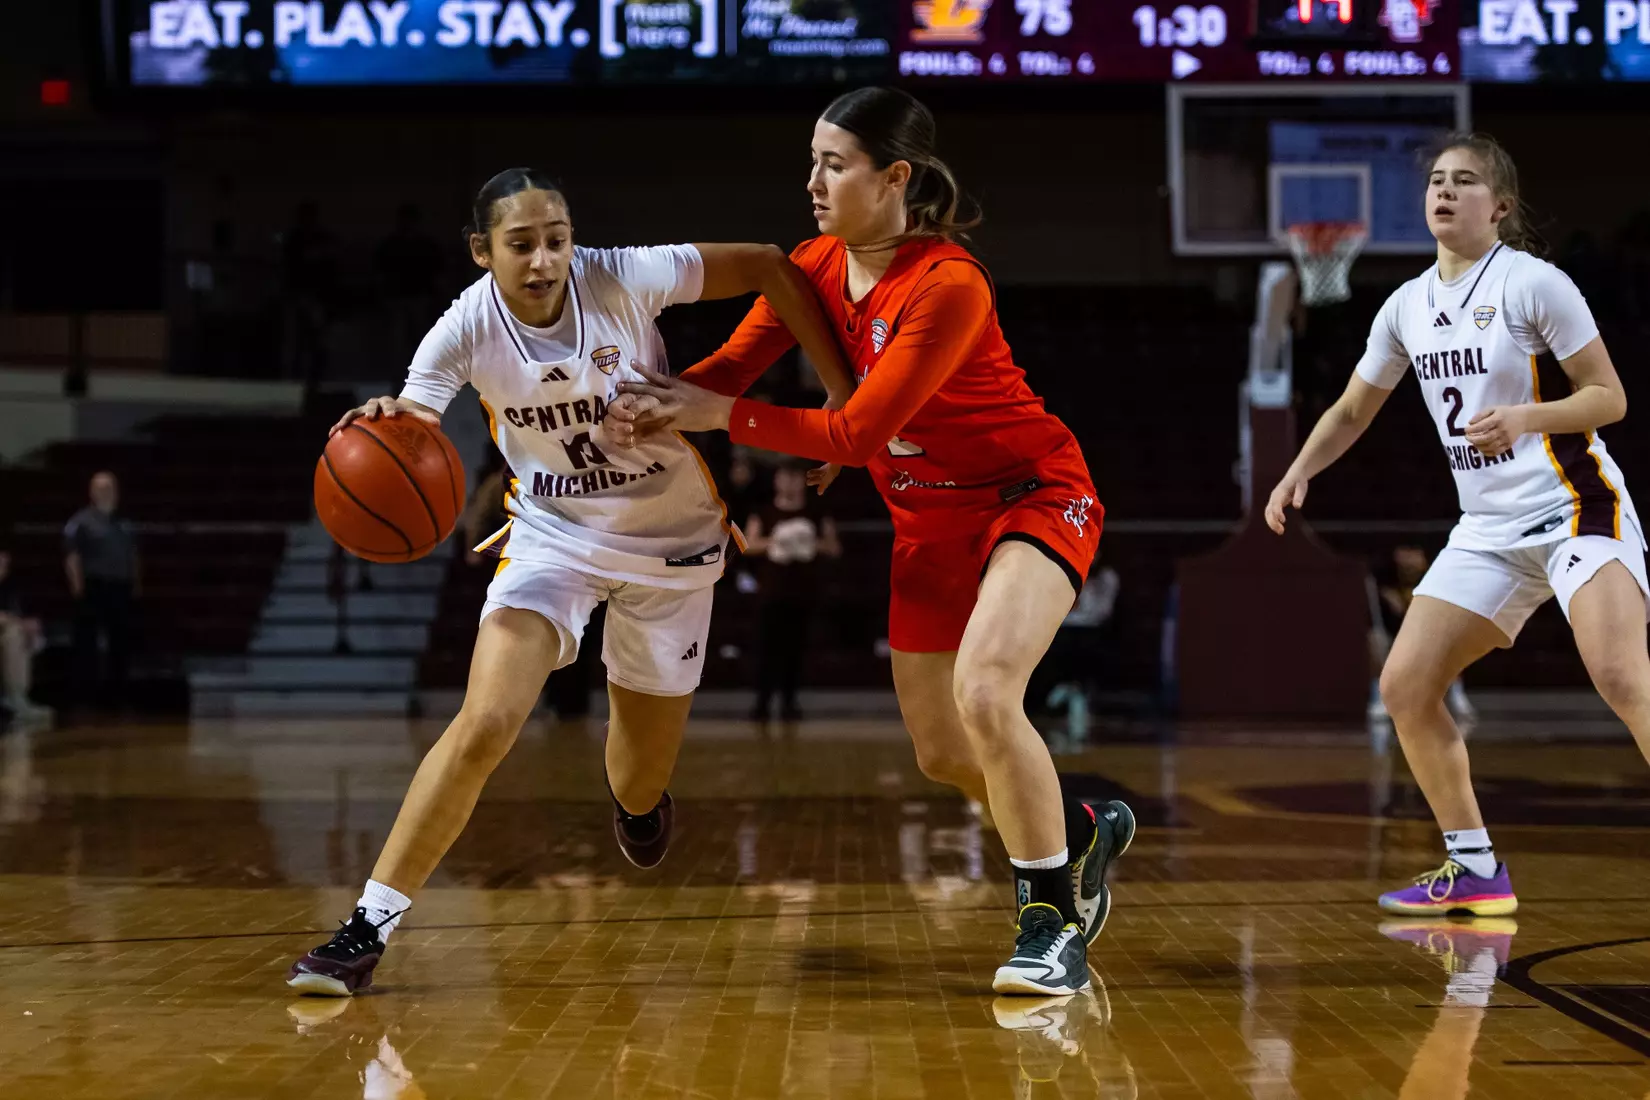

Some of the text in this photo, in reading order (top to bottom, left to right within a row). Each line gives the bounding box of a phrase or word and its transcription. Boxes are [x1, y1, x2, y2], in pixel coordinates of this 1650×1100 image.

[150, 0, 591, 48] EAT. PLAY. STAY.
[1133, 4, 1227, 47] 1:30
[1478, 0, 1594, 46] EAT.
[899, 51, 983, 76] FOULS:
[1343, 50, 1427, 75] FOULS:
[1415, 348, 1488, 380] CENTRAL
[504, 394, 612, 433] CENTRA
[1442, 386, 1466, 437] 2
[1446, 444, 1515, 471] CHIGAN
